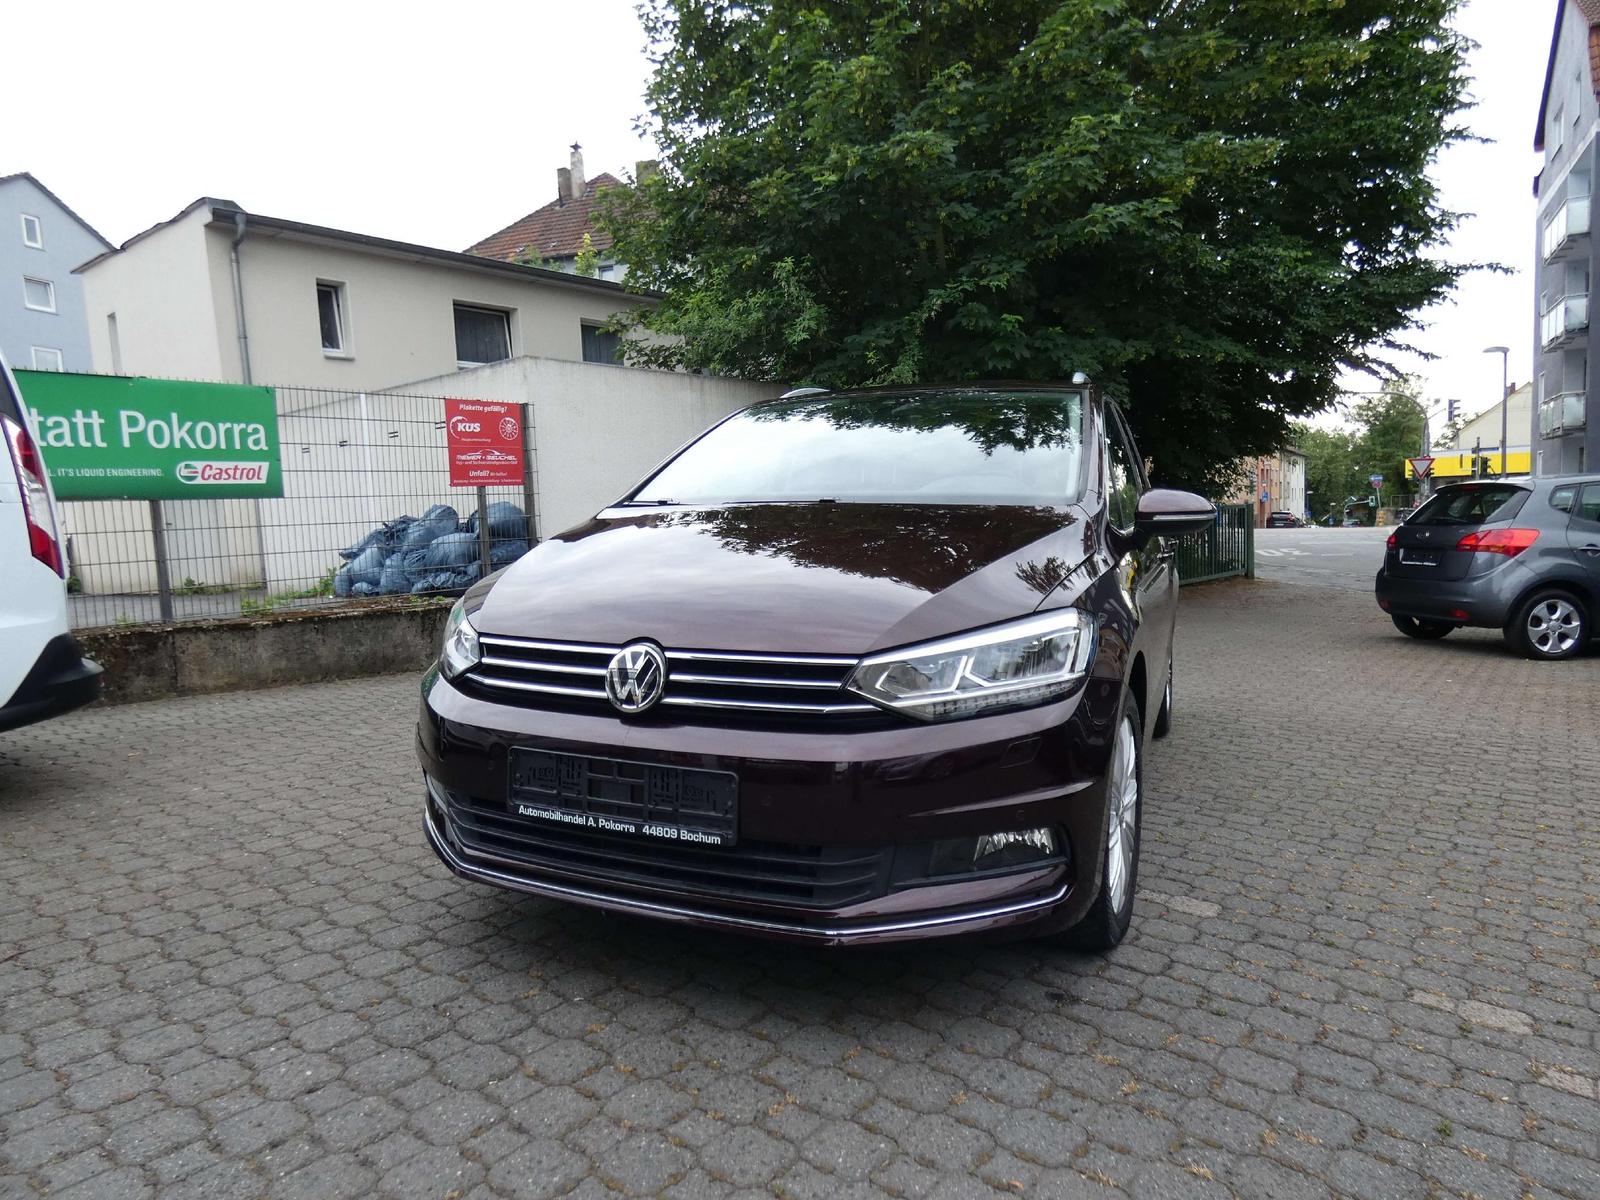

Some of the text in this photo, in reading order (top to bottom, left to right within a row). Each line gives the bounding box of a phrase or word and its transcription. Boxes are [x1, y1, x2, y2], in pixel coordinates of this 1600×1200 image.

[119, 409, 269, 451] Pokorra
[57, 467, 74, 477] IT'S
[76, 467, 105, 477] LIQUID
[200, 464, 264, 481] Castrol
[518, 804, 721, 845] Automobilhandel A. Pokorra 44809 Bochum
